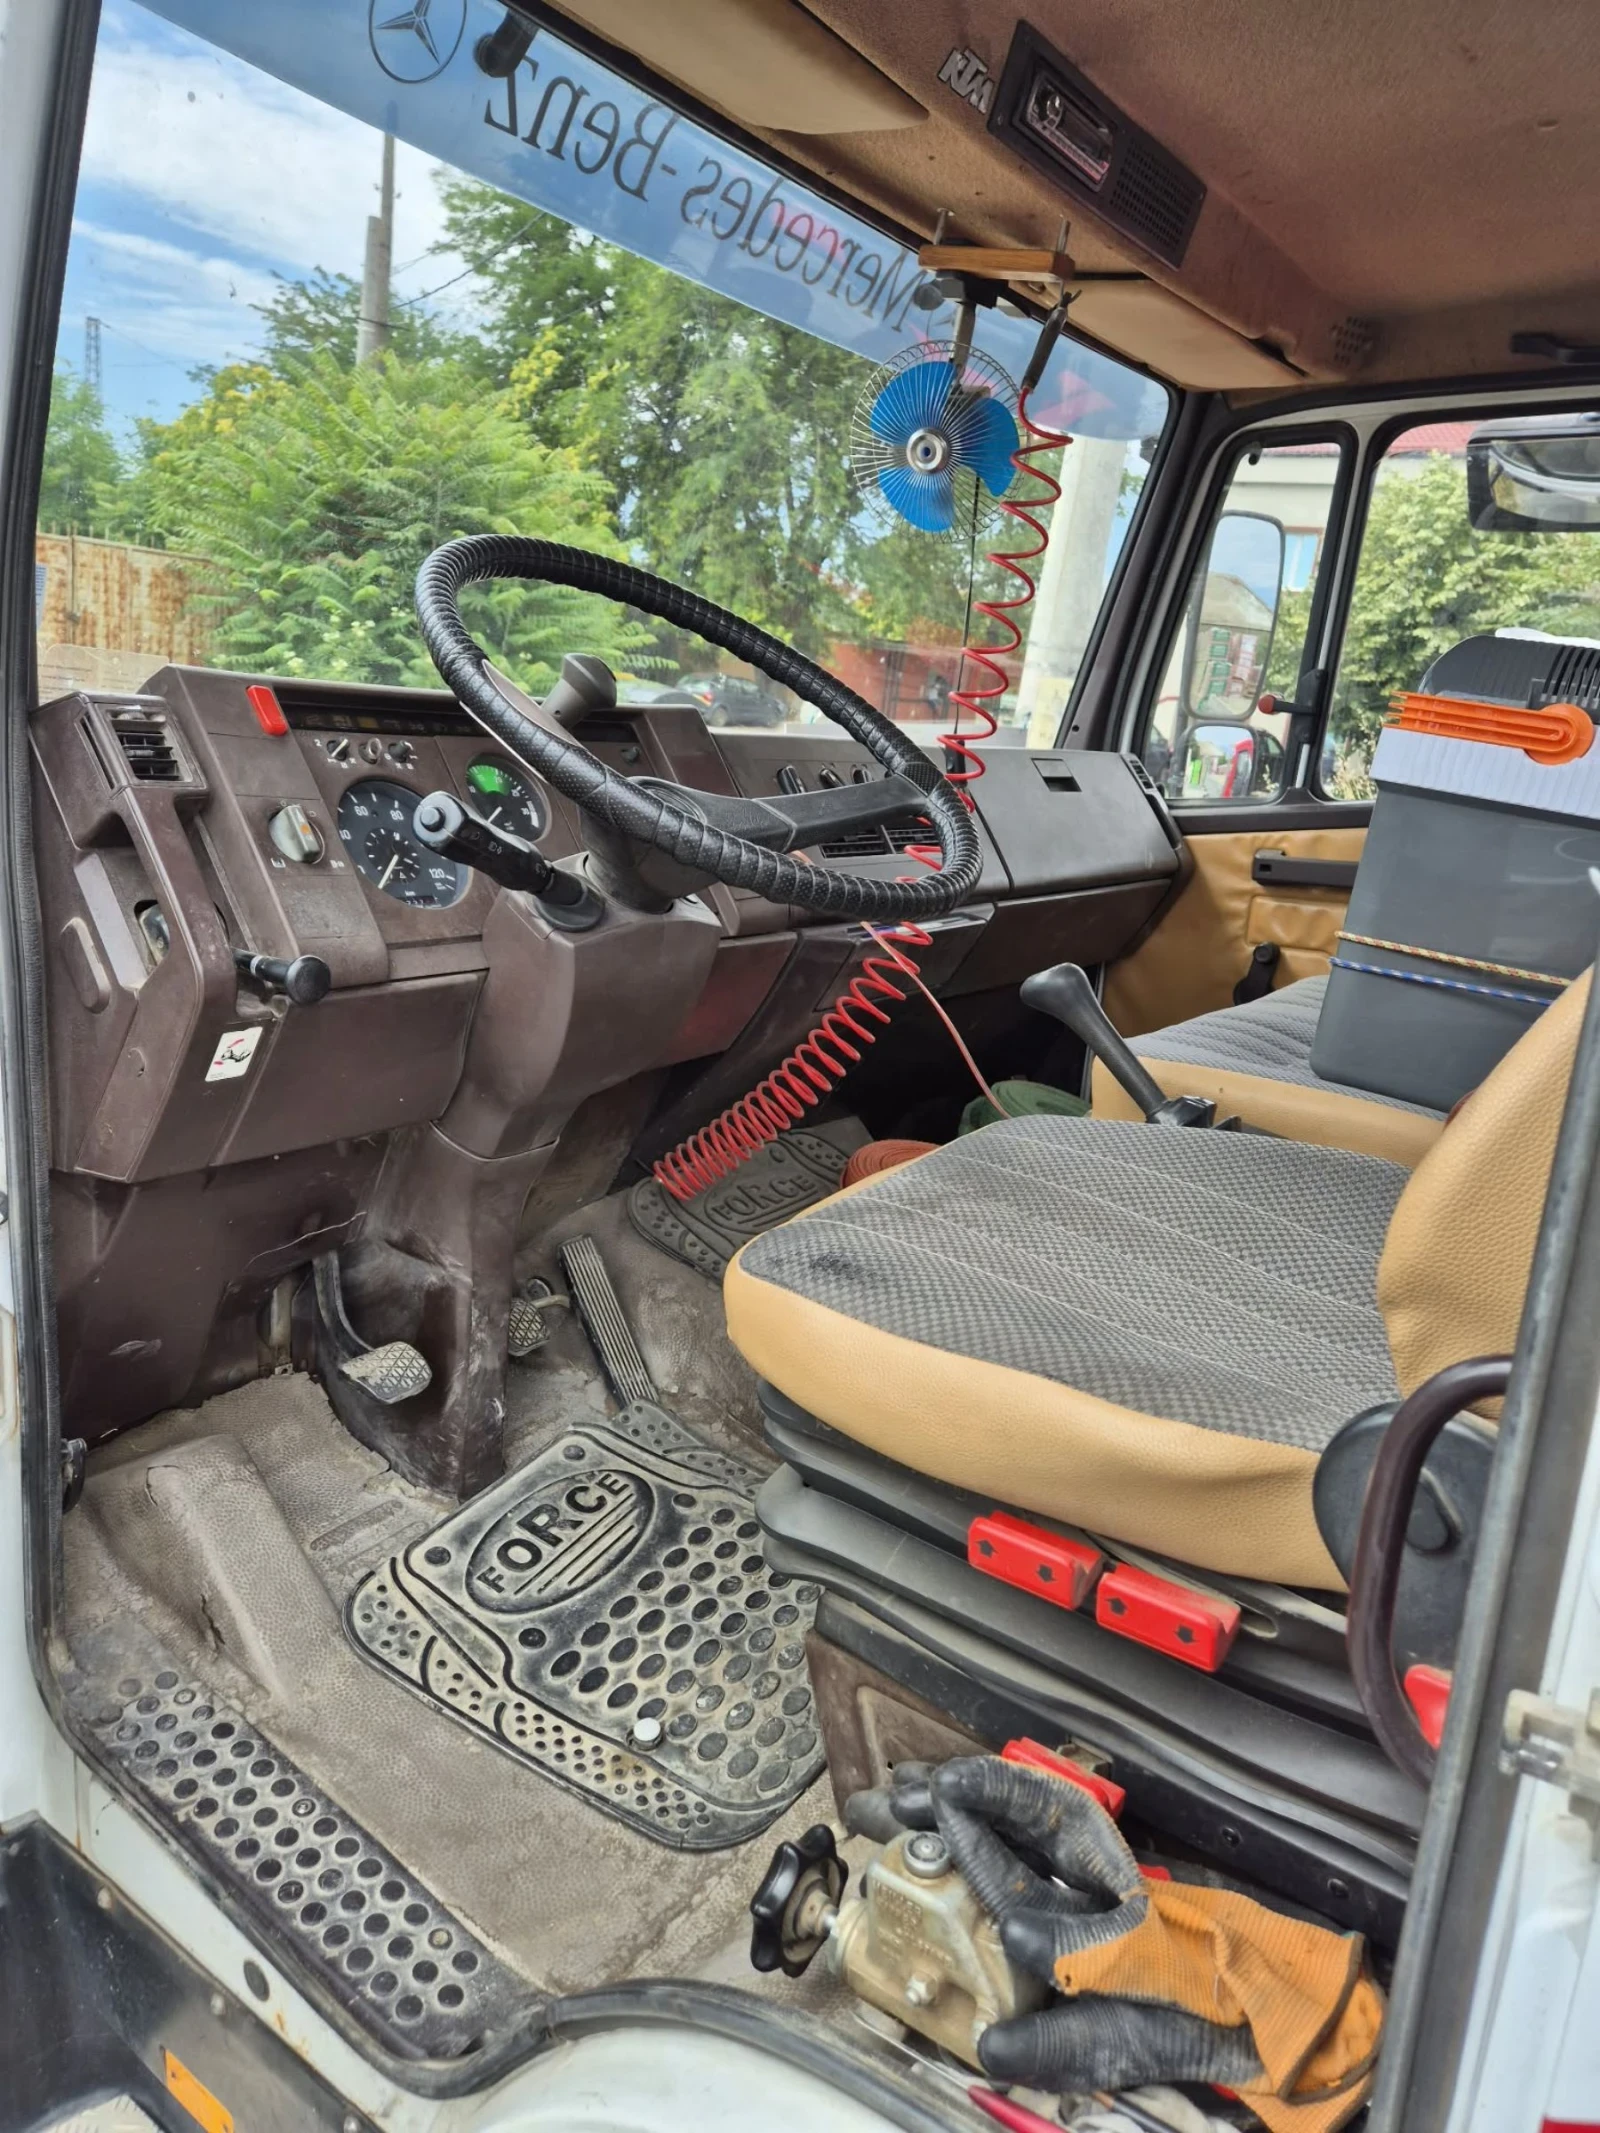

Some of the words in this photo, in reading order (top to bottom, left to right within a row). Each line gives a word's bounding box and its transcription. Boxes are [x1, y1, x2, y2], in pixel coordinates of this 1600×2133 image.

[938, 47, 994, 114] KTM
[353, 805, 369, 817] 60
[390, 810, 404, 820] 80
[429, 868, 445, 879] 120
[711, 1174, 818, 1221] FORCE
[476, 1472, 630, 1594] FORCE
